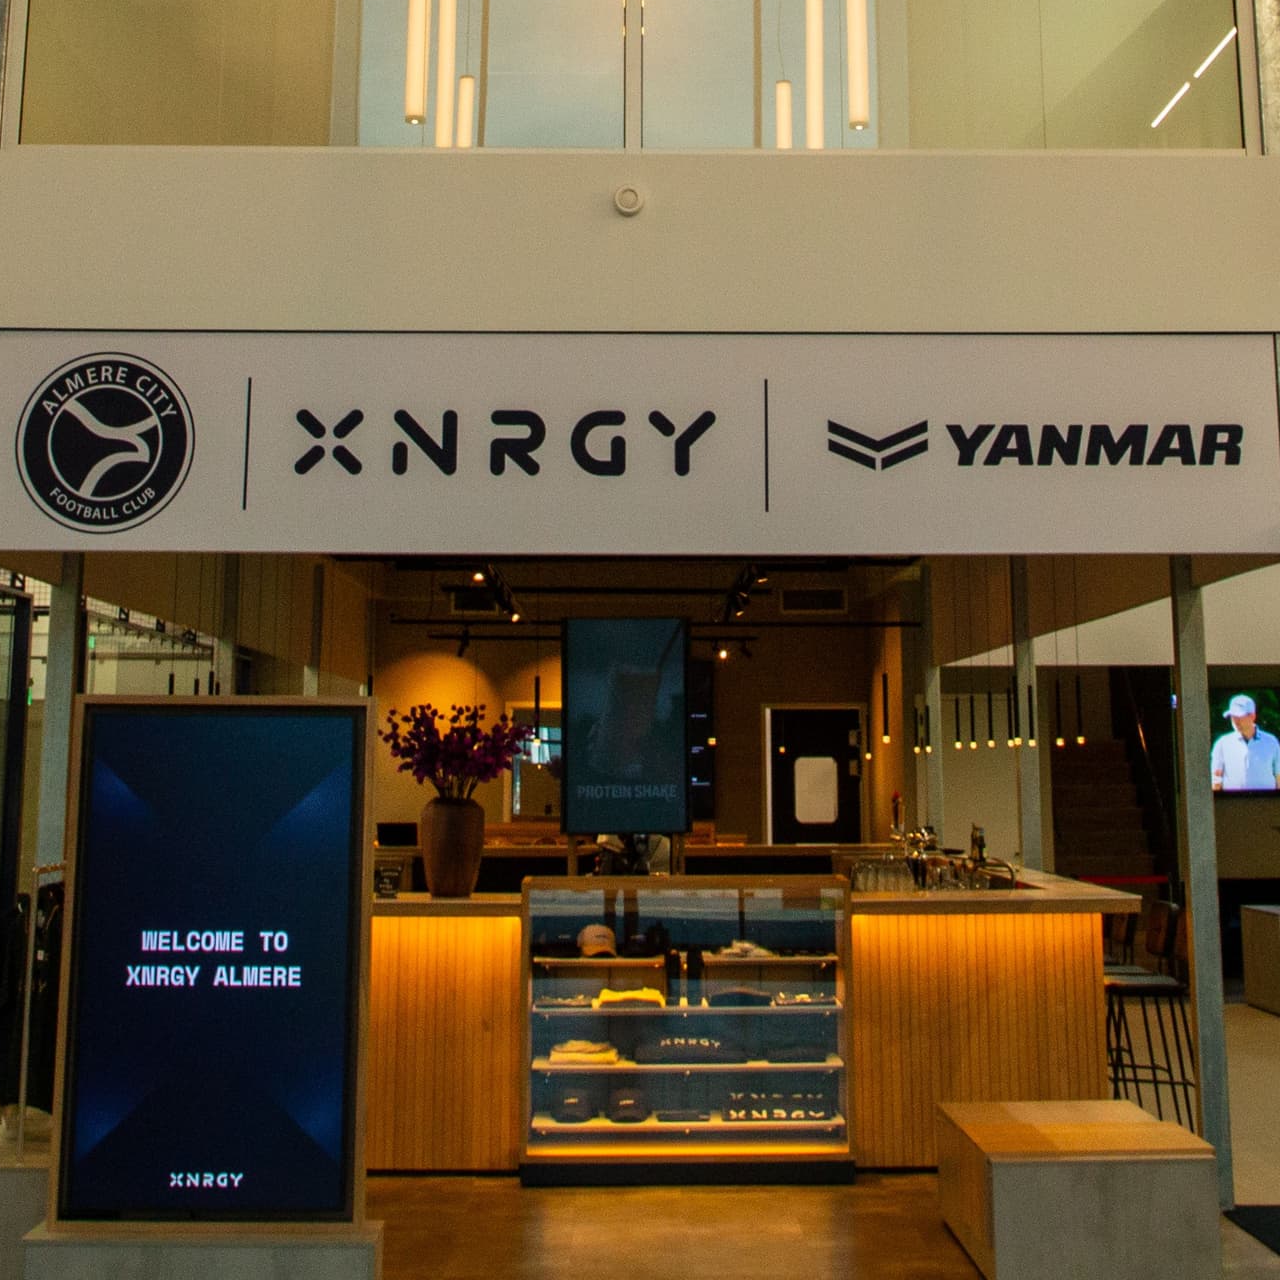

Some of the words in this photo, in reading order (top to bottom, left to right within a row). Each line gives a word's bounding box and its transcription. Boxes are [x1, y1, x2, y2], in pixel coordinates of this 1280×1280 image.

[41, 365, 128, 416] ALMERE
[135, 375, 178, 417] CITY
[293, 408, 717, 476] XNRGY
[945, 423, 1244, 467] YANMAR
[49, 487, 119, 520] FOOTBALL
[122, 487, 156, 515] CLUB
[575, 783, 632, 800] PROTEIN
[634, 783, 678, 802] SHAKE
[141, 930, 244, 952] WELCOME
[260, 930, 288, 952] TO
[125, 964, 201, 987] XNRGY
[213, 964, 302, 987] ALMERE
[169, 1172, 243, 1188] XNRGY
